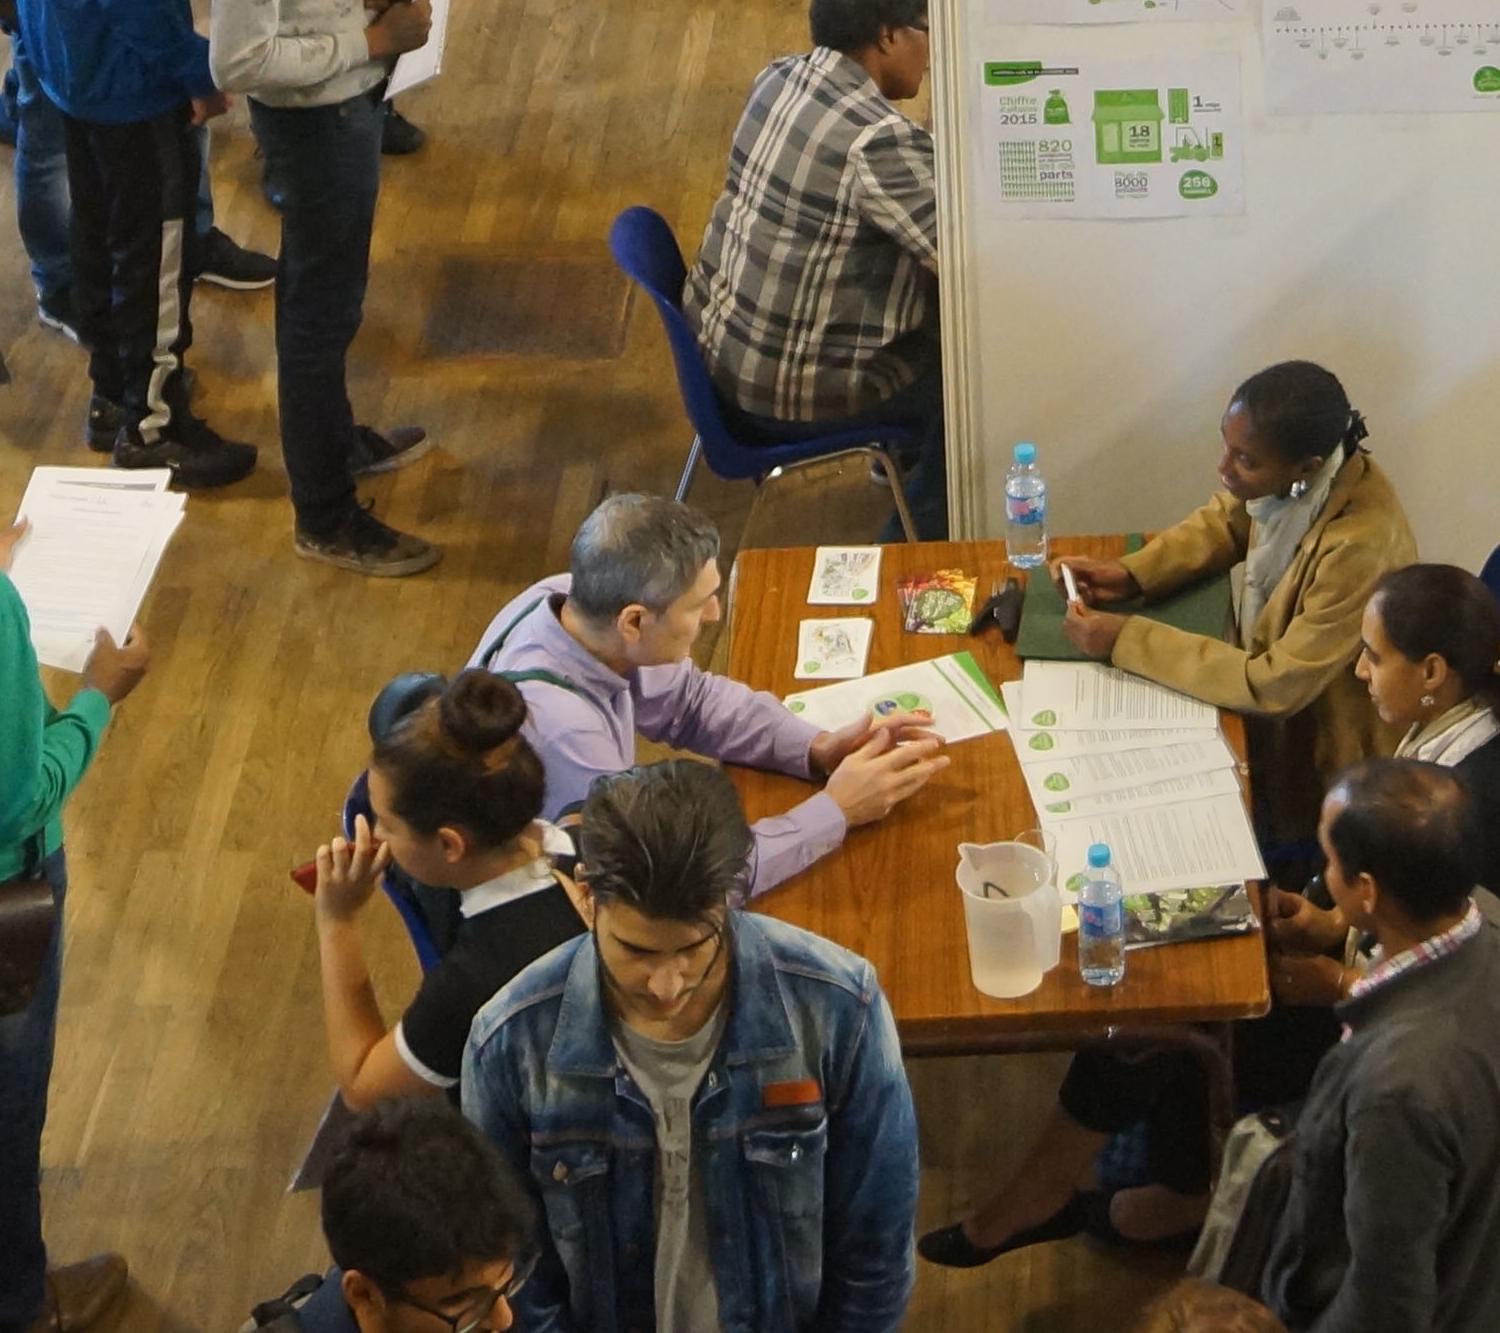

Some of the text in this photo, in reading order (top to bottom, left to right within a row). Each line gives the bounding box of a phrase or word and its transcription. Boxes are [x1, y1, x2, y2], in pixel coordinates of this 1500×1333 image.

[1000, 114, 1038, 125] 2015
[1128, 125, 1150, 138] 18
[1038, 139, 1073, 153] 820
[1039, 171, 1074, 182] parts
[1114, 177, 1149, 188] 8000
